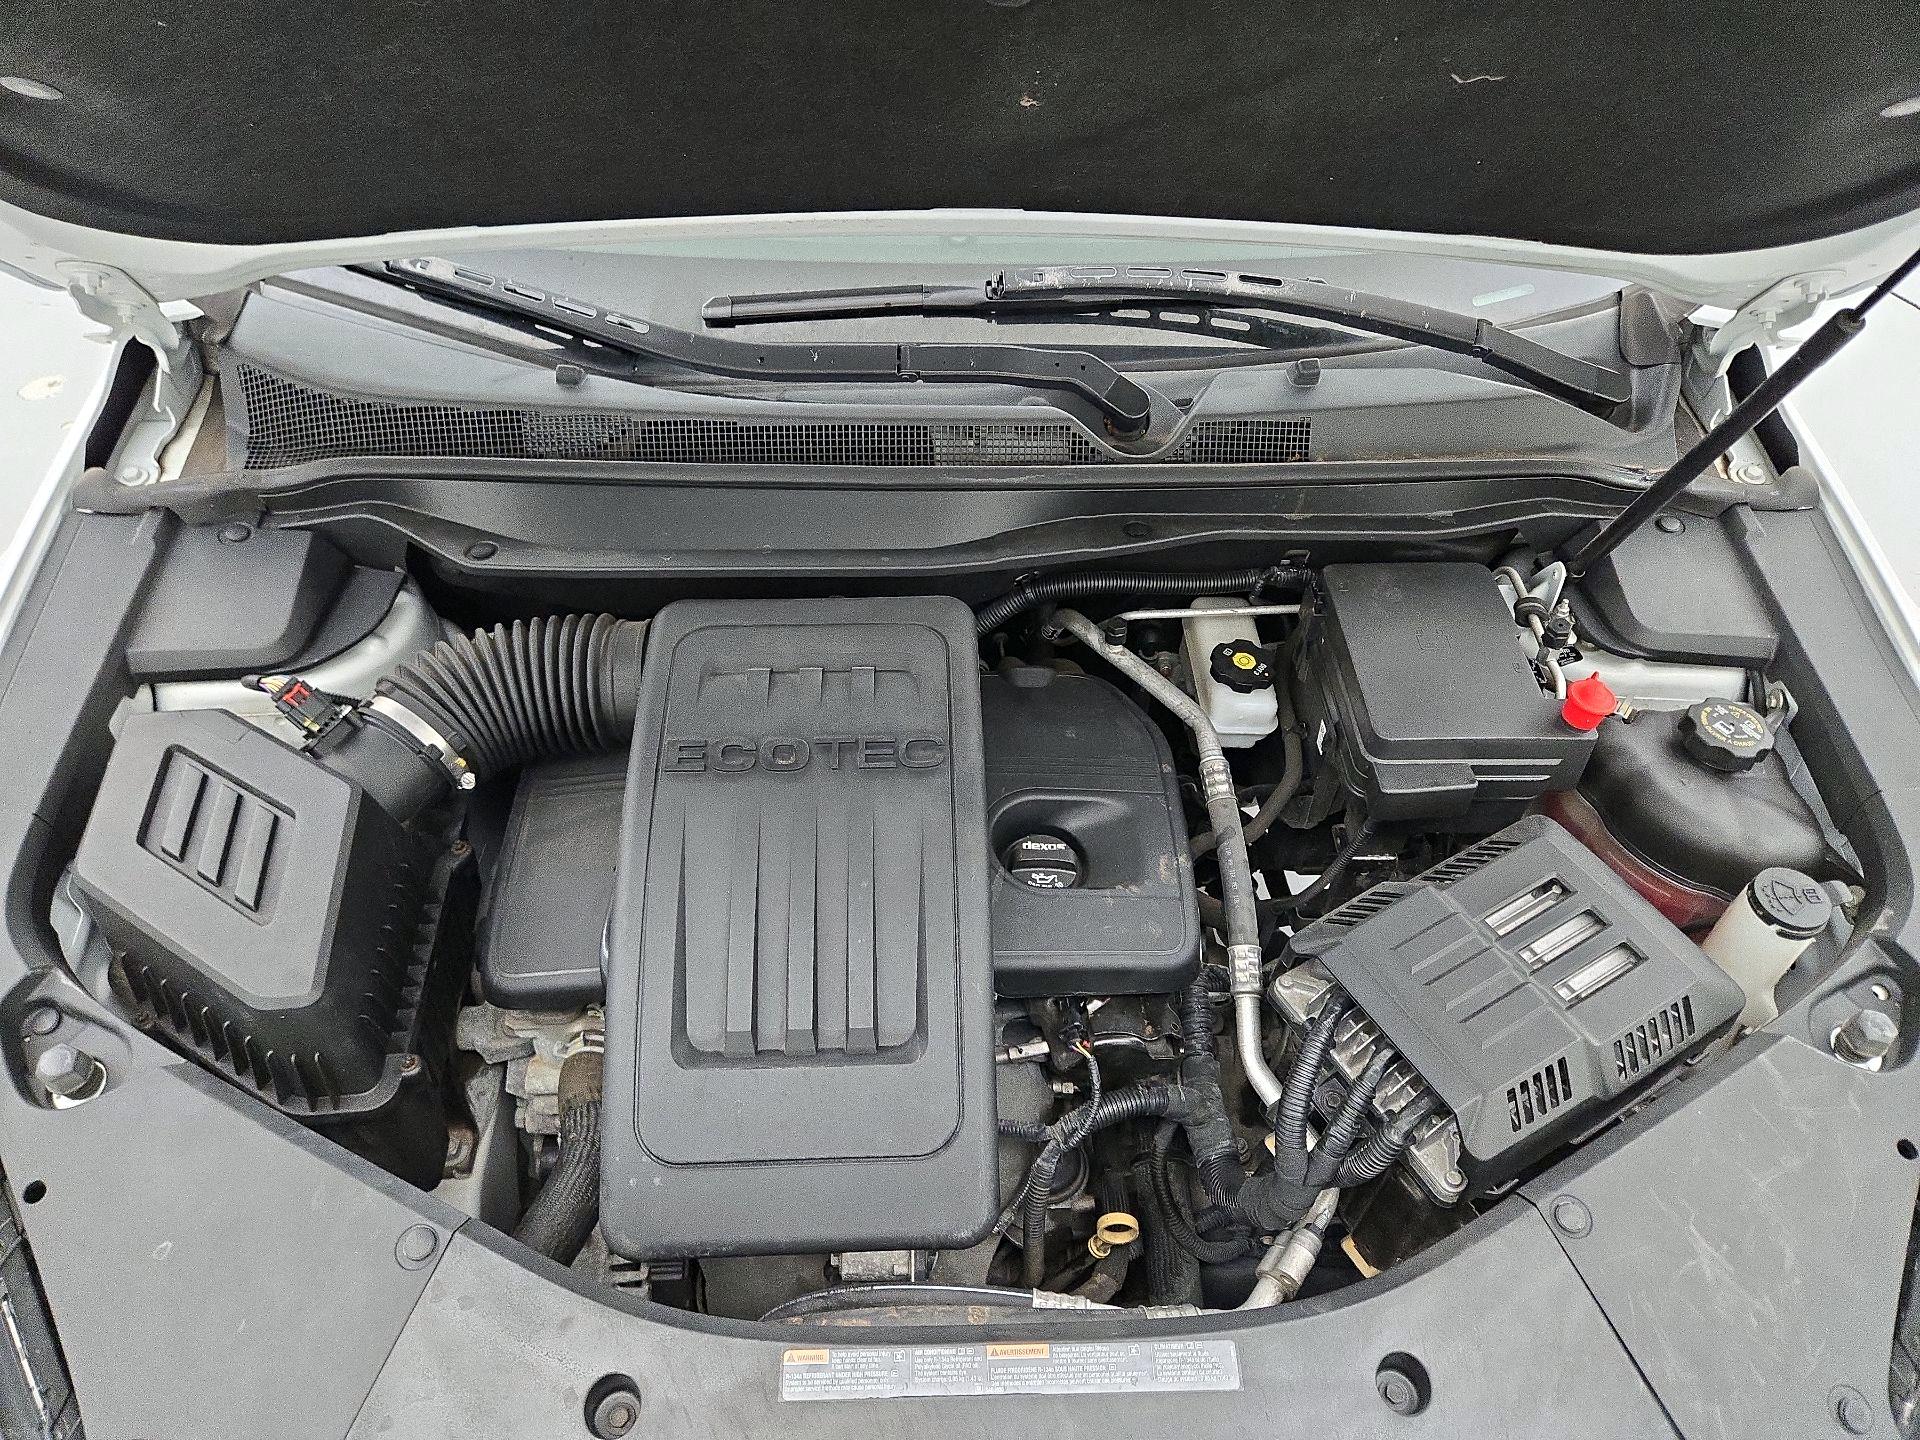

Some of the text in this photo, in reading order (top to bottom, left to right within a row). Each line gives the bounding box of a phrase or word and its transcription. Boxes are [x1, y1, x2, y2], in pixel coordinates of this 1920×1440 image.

[664, 735, 946, 772] ECOTEC
[1022, 841, 1067, 851] dexos
[1000, 1348, 1045, 1356] AVERTISSEMENT
